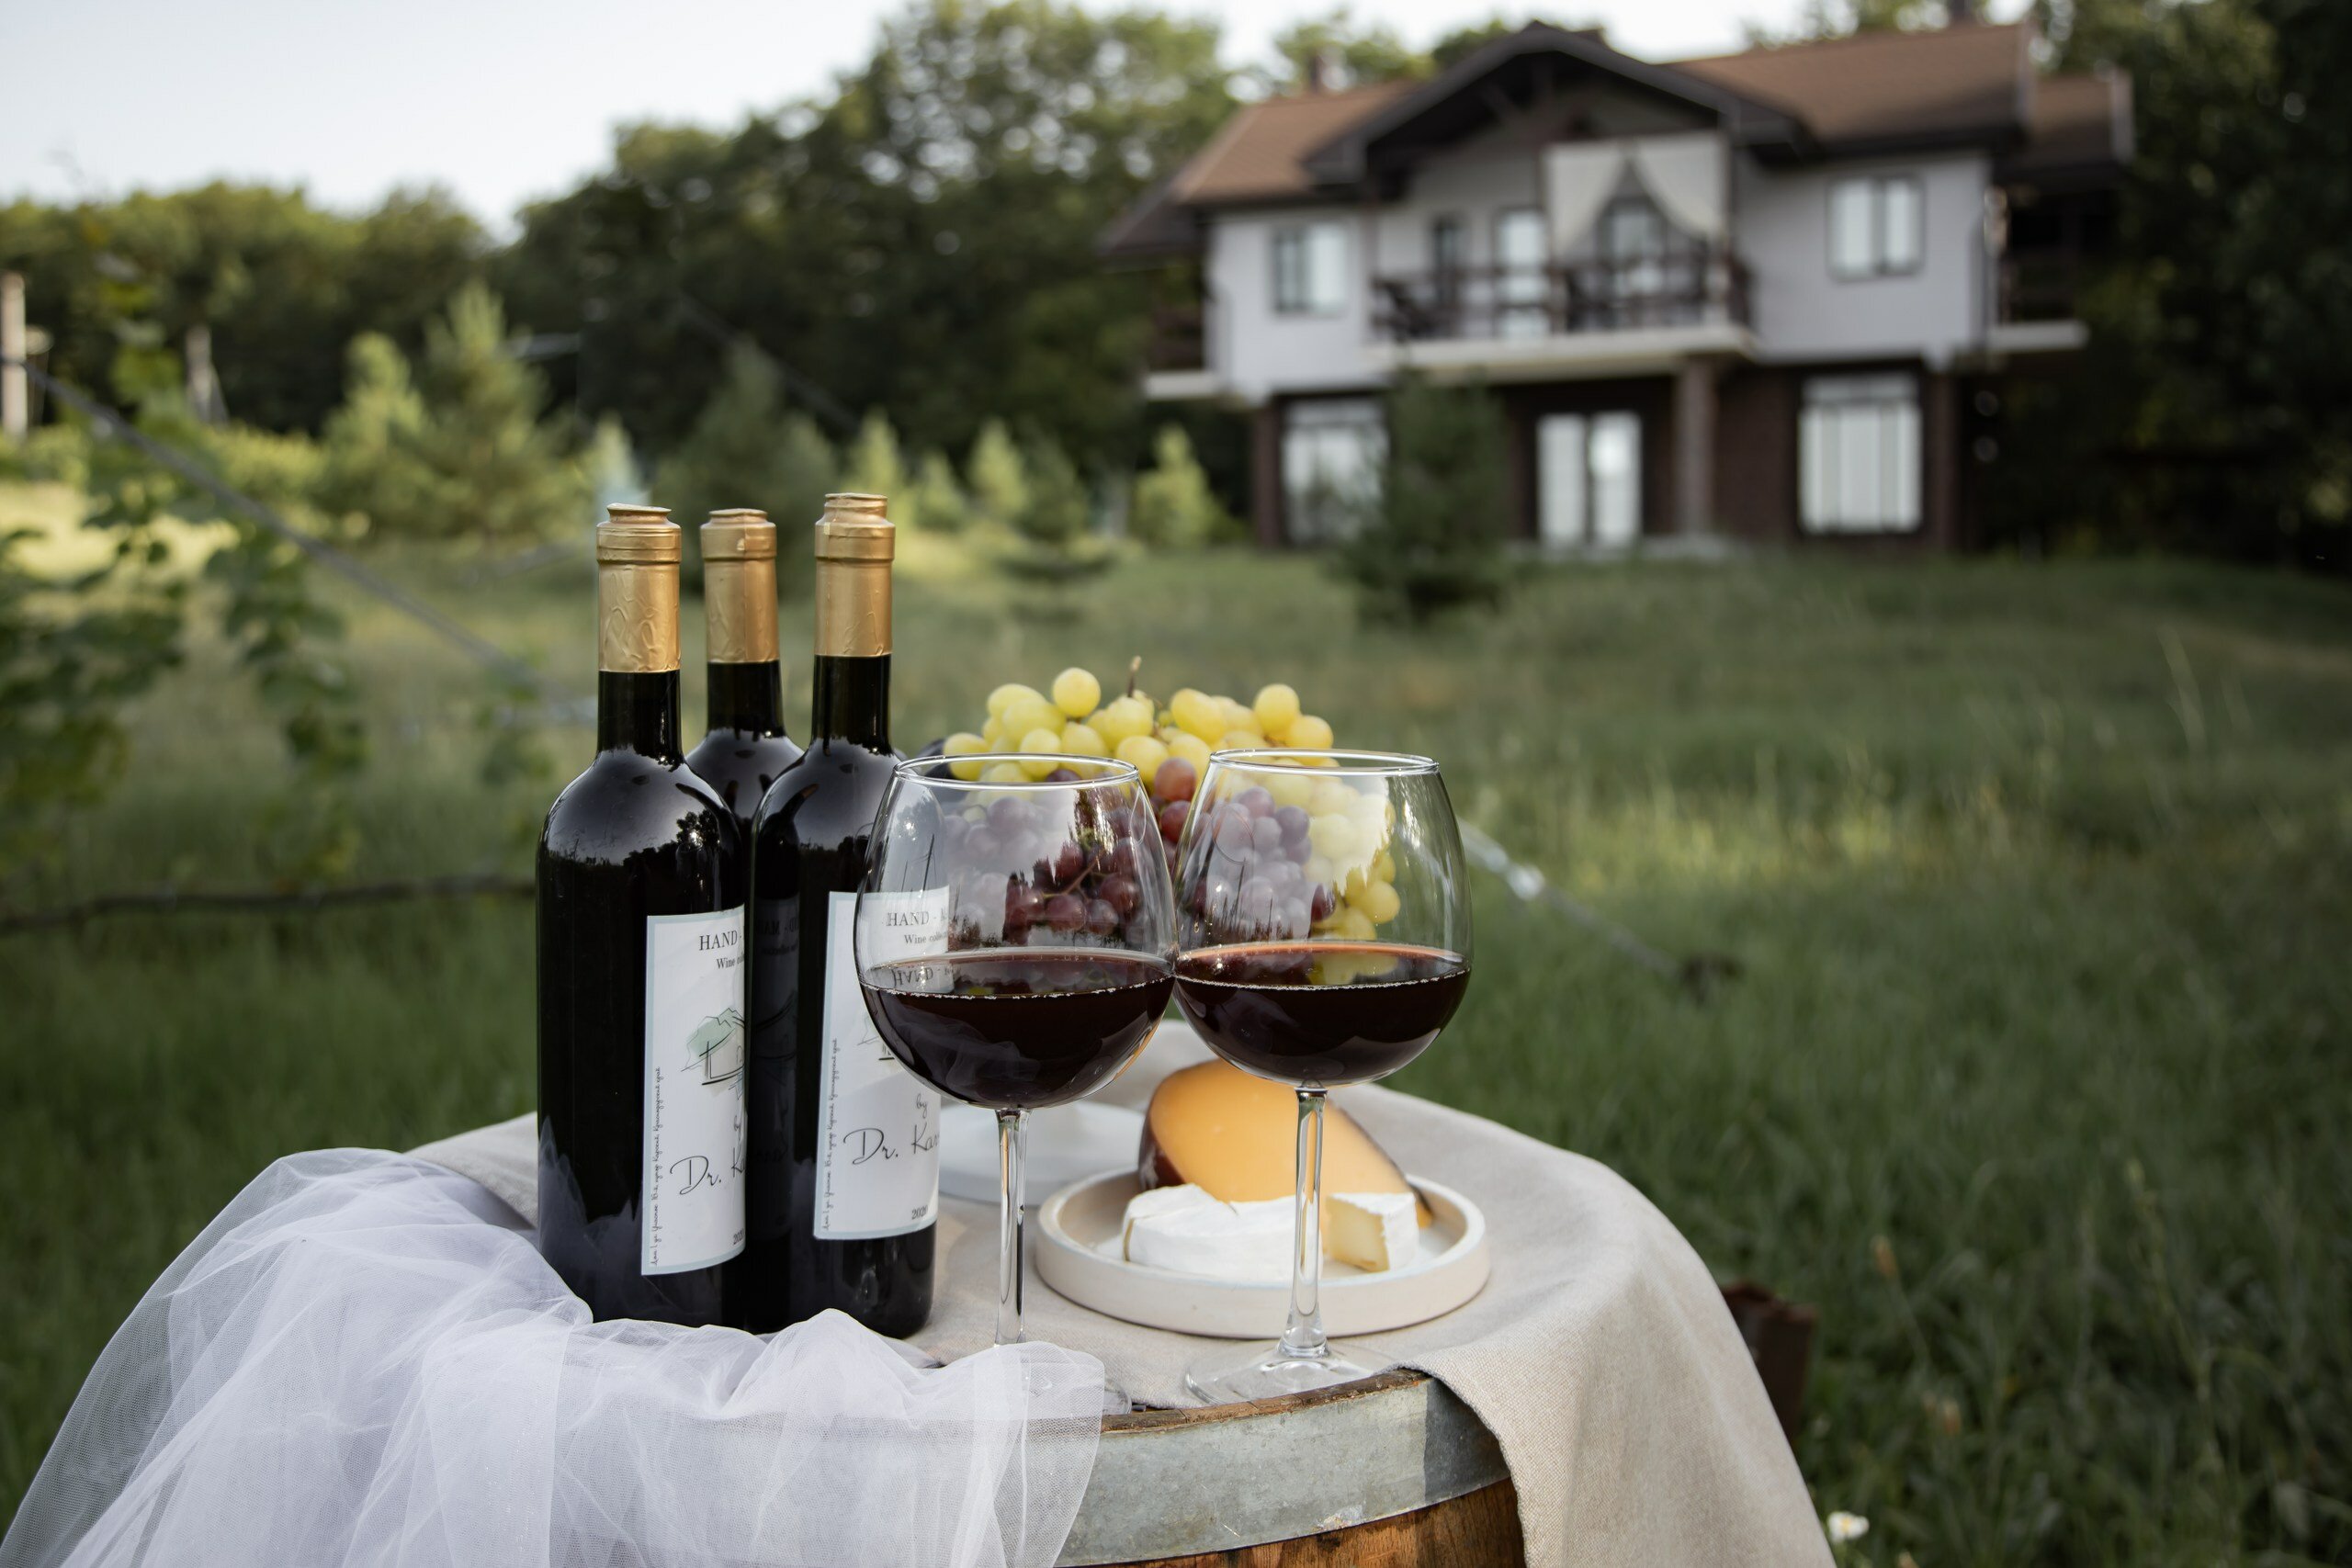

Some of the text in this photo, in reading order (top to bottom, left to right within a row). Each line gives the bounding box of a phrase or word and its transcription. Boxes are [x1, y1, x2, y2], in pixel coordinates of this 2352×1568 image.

[886, 910, 929, 927] HAND
[698, 930, 738, 951] HAND
[904, 933, 927, 944] Wine
[717, 957, 736, 969] Wine
[916, 1093, 927, 1119] by
[842, 1127, 899, 1165] Dr.
[670, 1155, 722, 1195] Dr.
